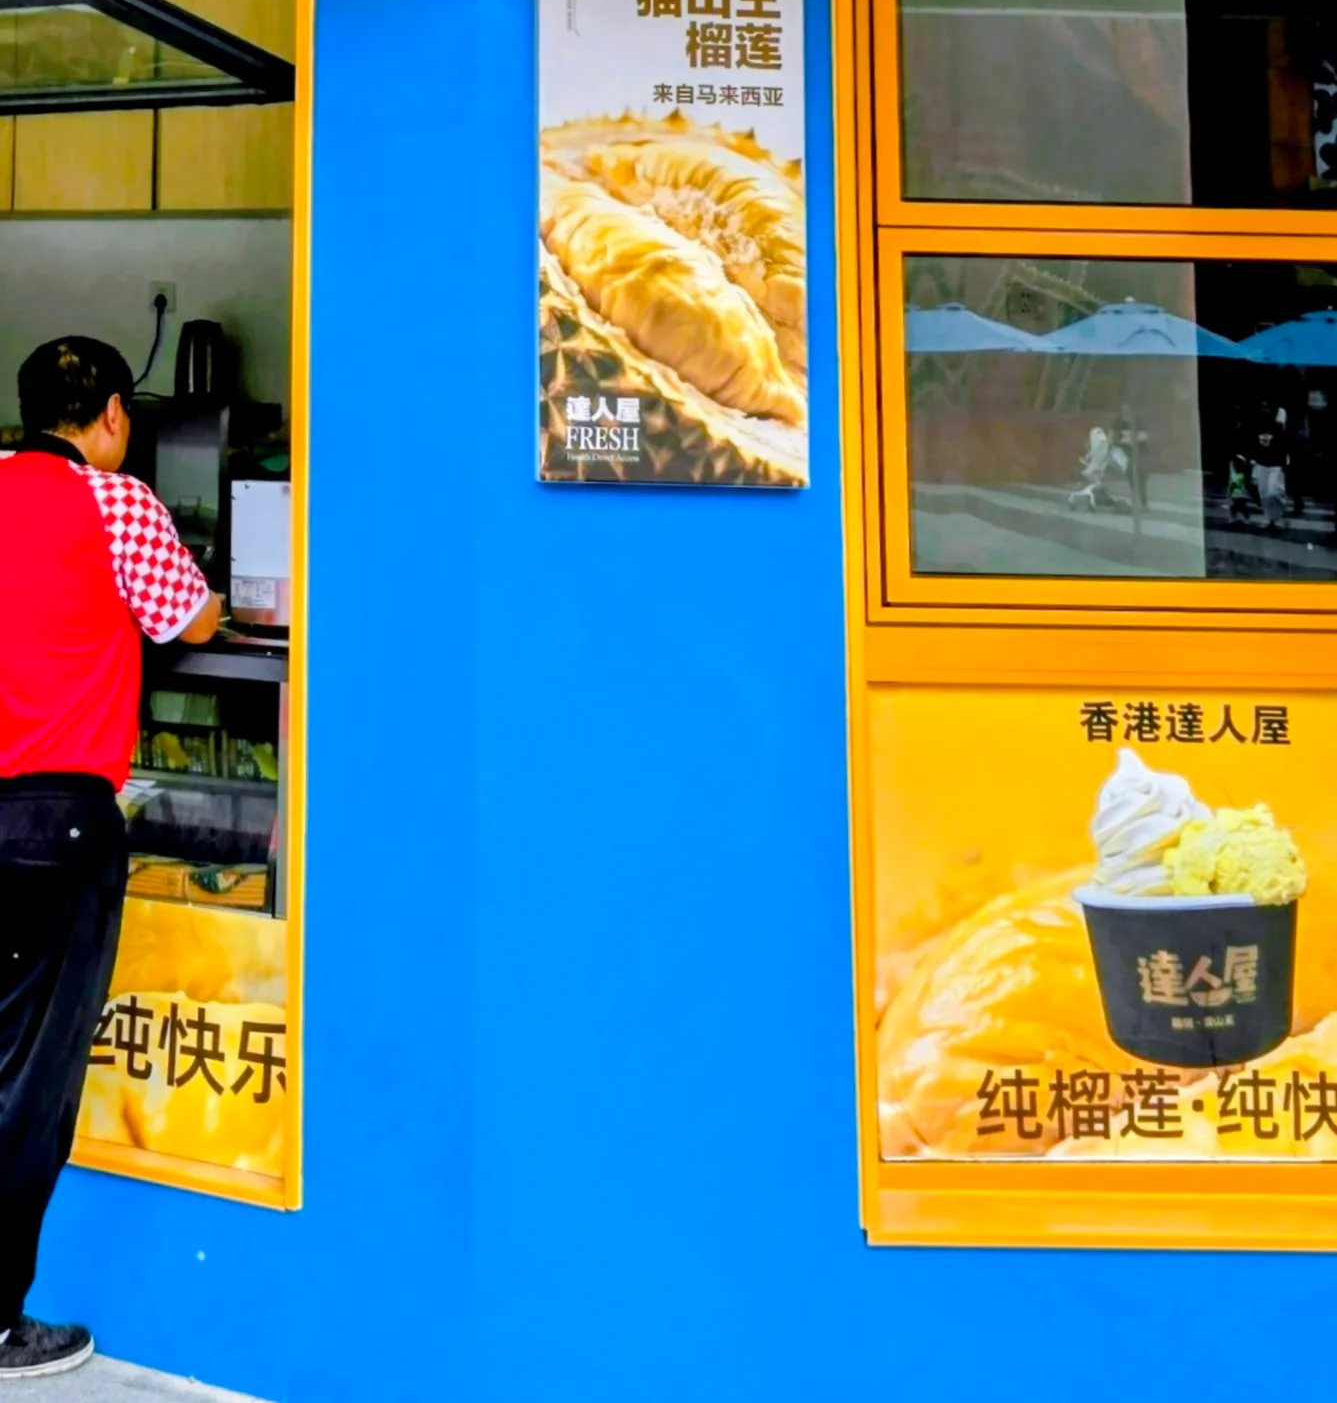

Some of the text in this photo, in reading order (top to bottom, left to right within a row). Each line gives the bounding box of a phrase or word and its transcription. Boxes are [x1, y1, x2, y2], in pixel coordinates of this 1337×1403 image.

[685, 21, 782, 70] 榴莲
[652, 83, 784, 107] 来自马来西亚
[566, 396, 640, 423] 達人屋
[565, 426, 640, 451] FRESH
[1080, 701, 1290, 745] 香港達人屋
[1137, 945, 1258, 1007] 達人屋
[88, 995, 286, 1104] 纯快乐
